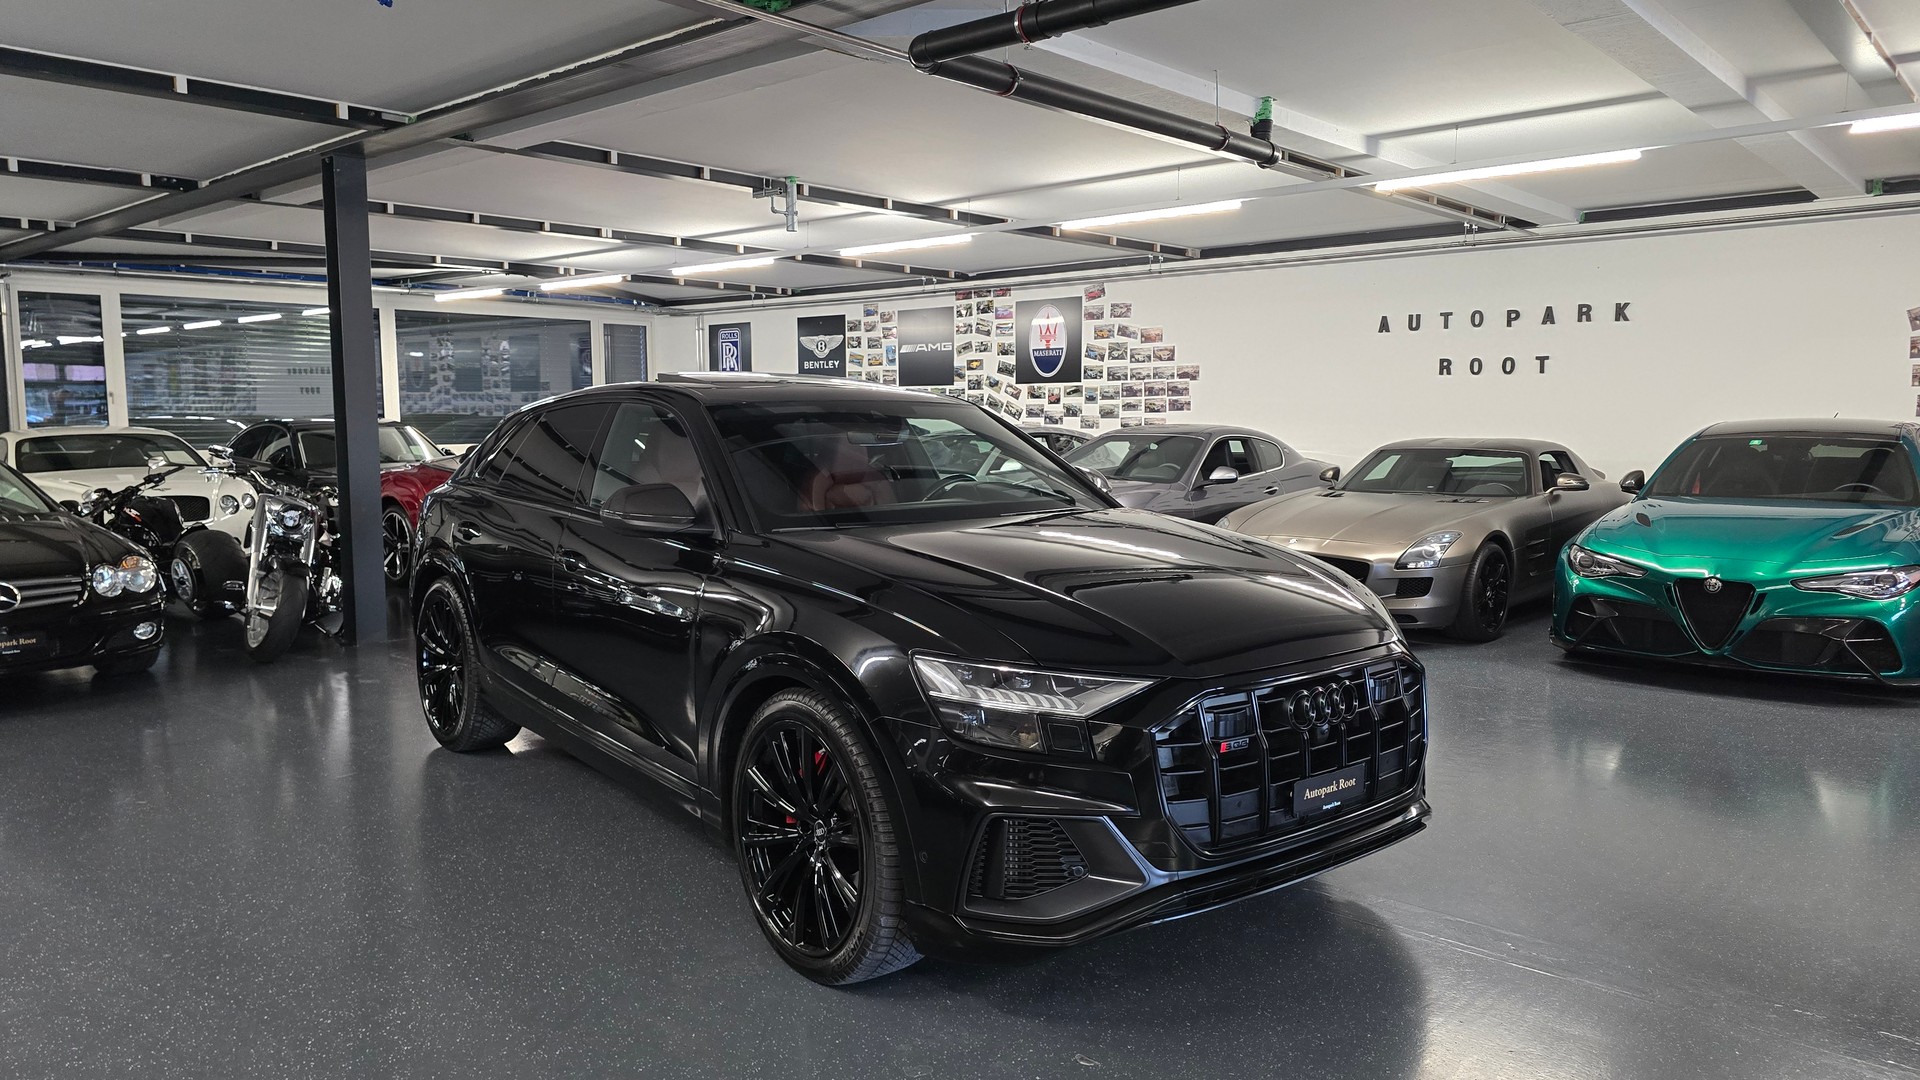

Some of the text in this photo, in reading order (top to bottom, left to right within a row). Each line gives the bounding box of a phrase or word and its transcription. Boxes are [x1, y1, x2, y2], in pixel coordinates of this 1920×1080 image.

[1378, 302, 1631, 333] AUTOPARK
[915, 343, 952, 352] AMG
[804, 360, 840, 369] BENTLEY
[1438, 355, 1550, 375] ROOT
[1304, 778, 1356, 800] Autopark Root
